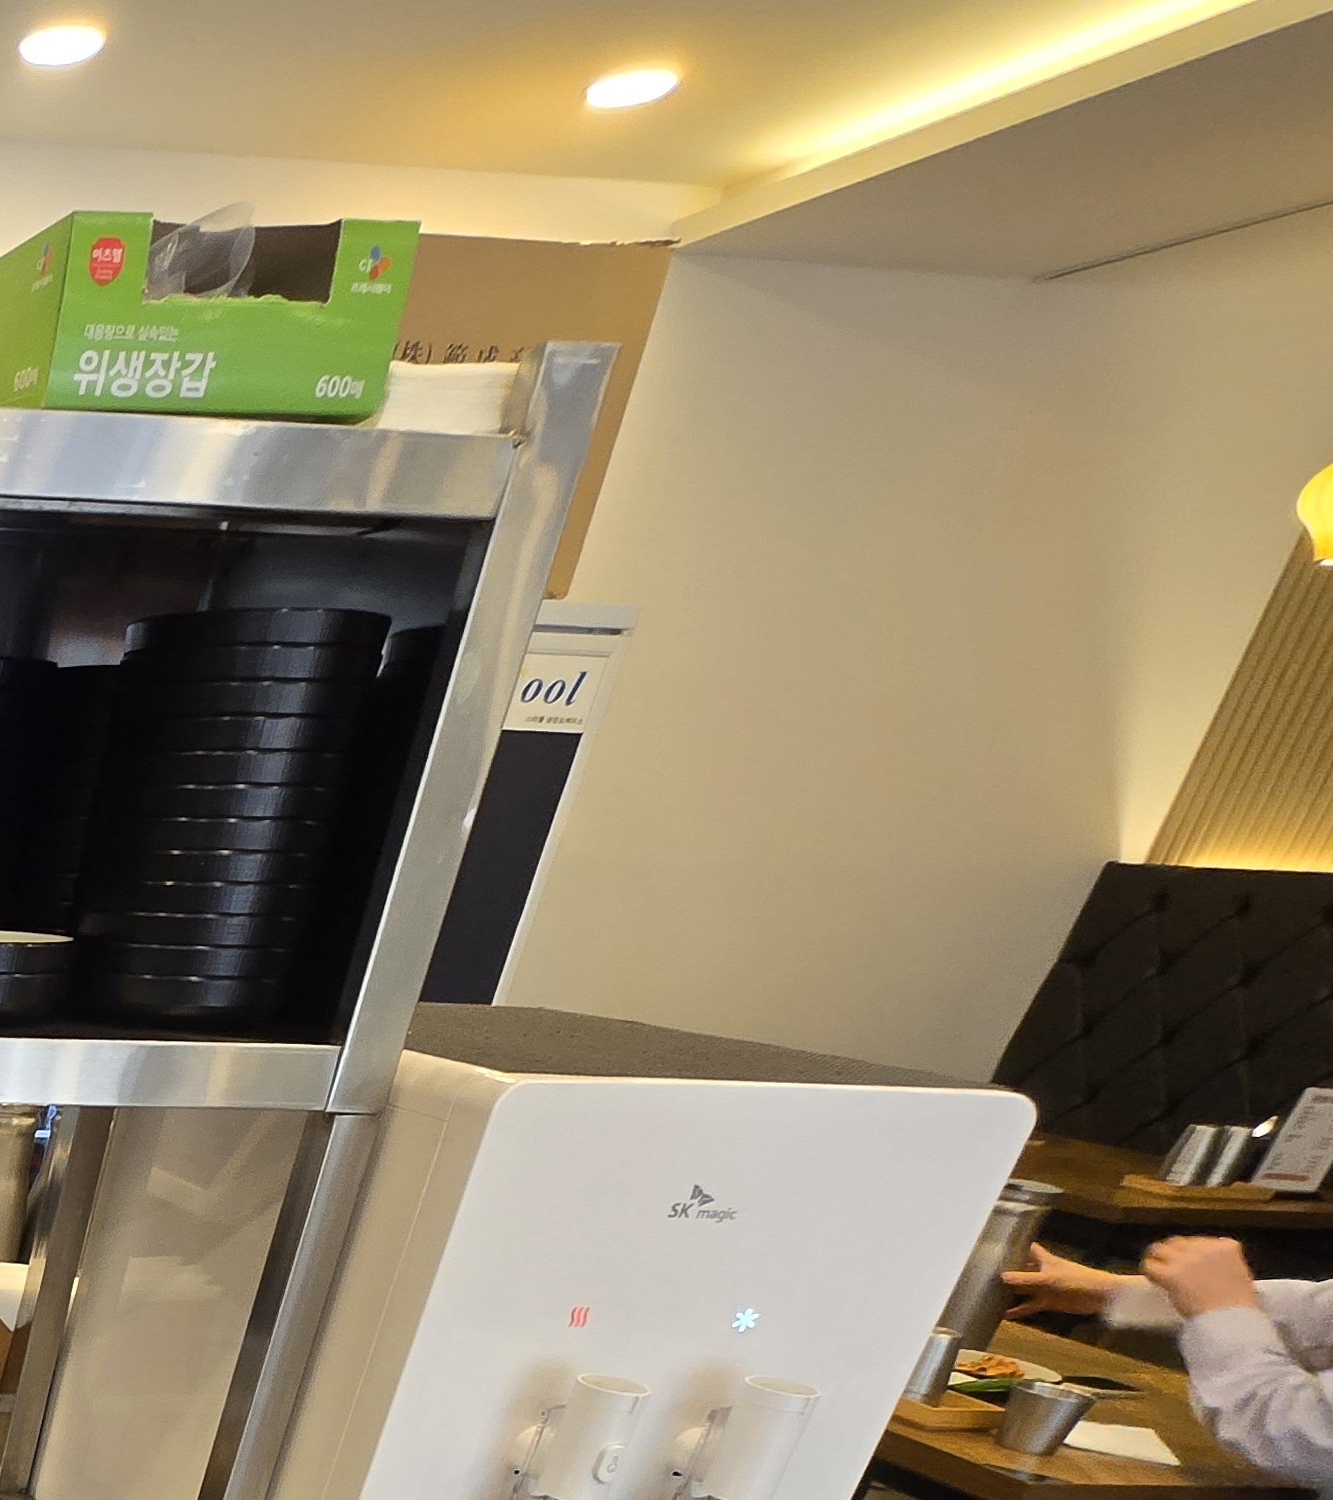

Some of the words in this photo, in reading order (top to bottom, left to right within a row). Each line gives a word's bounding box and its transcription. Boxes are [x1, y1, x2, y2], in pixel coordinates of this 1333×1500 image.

[73, 349, 217, 399] 위생장갑
[315, 374, 366, 400] 600매
[667, 1202, 695, 1218] SK
[695, 1207, 738, 1223] magic
